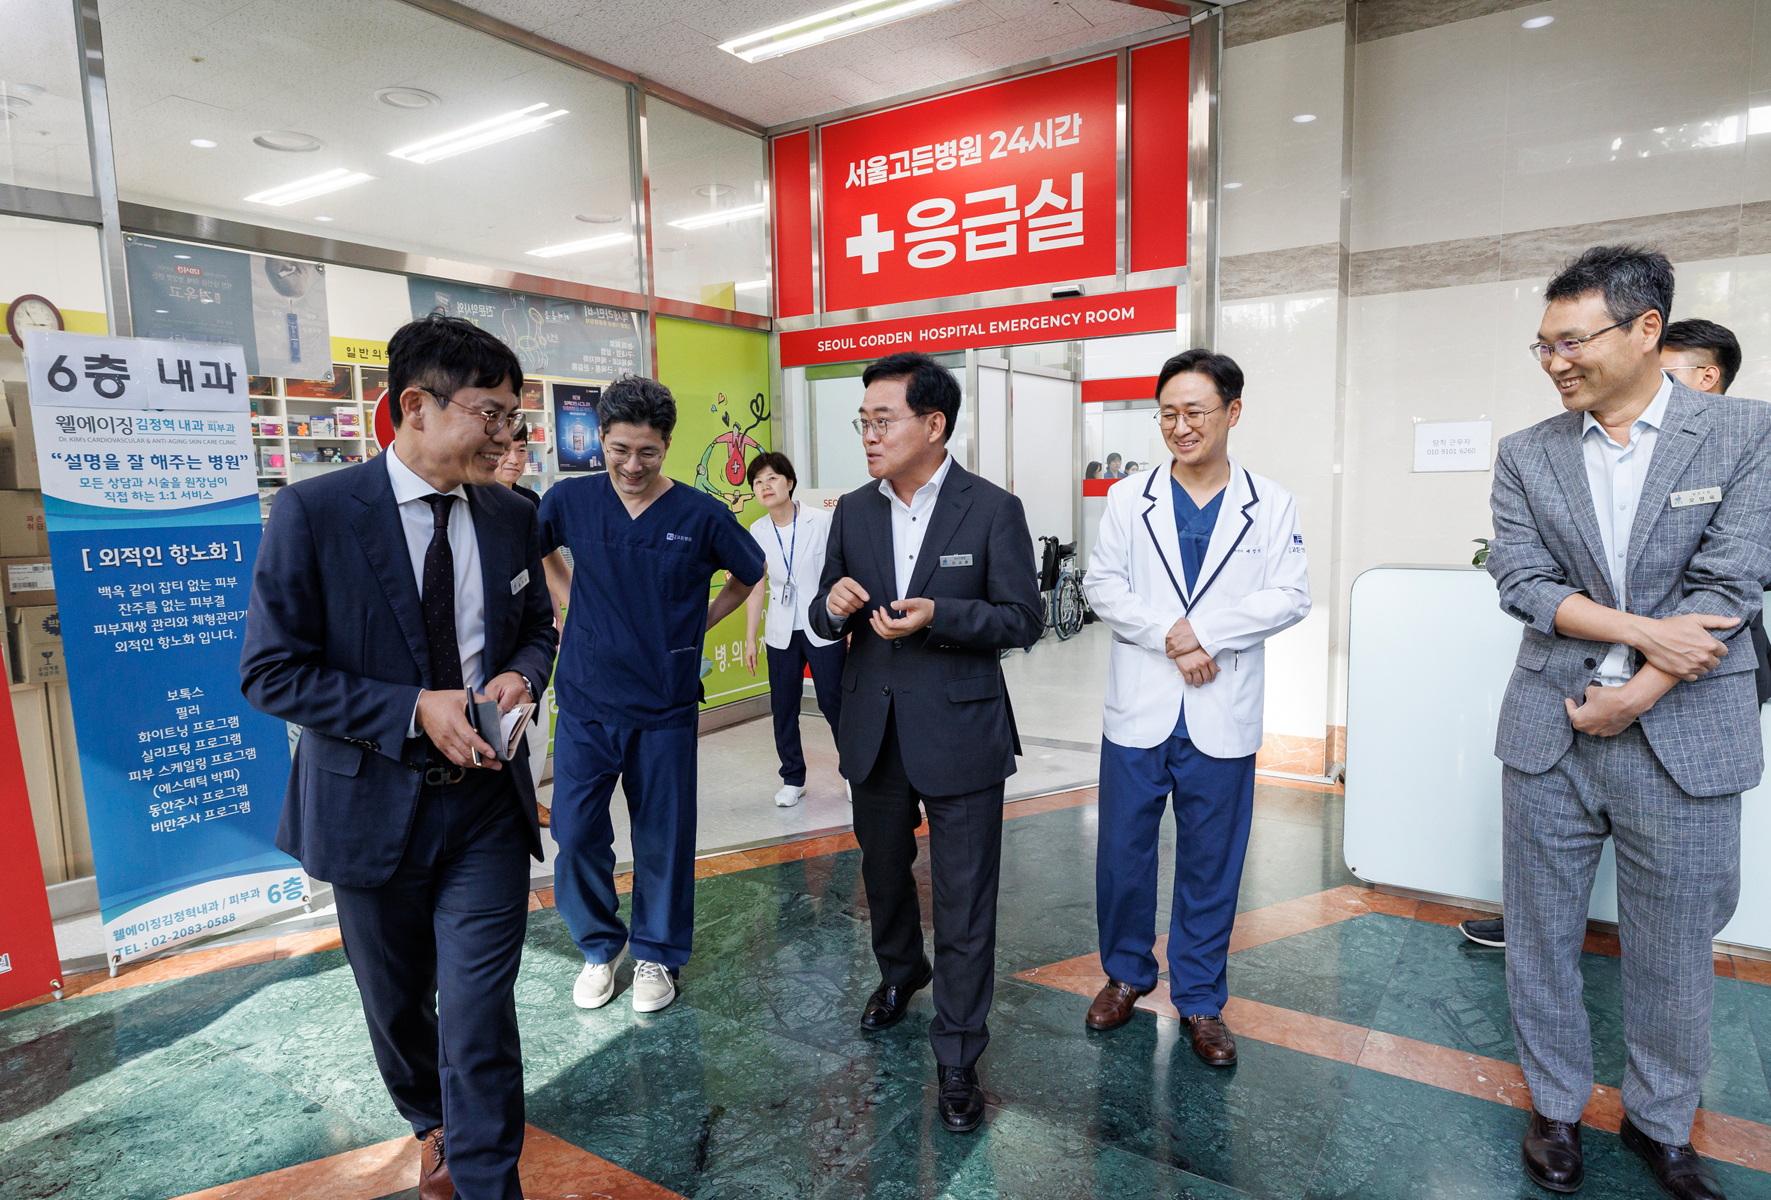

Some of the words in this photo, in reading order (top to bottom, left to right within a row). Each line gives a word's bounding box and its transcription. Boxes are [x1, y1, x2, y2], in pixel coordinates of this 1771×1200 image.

[845, 134, 981, 189] 서울고든병원
[989, 113, 1082, 160] 24시간
[904, 172, 1084, 269] 응급실
[817, 337, 856, 352] SEOUL
[859, 331, 912, 349] GORDEN
[919, 322, 985, 341] HOSPITAL
[989, 312, 1081, 335] EMERGENCY
[1085, 306, 1135, 324] ROOM
[47, 354, 131, 399] 6층
[157, 358, 237, 394] 내과
[55, 415, 133, 435] 웰에이징
[136, 418, 175, 431] 김정혁
[178, 419, 204, 432] 내과
[207, 423, 235, 433] 피부과
[1432, 439, 1447, 447] 당직
[1449, 438, 1471, 446] 근무자
[127, 453, 145, 471] 잘
[150, 454, 202, 471] 해주는
[79, 477, 104, 489] 모든
[108, 477, 143, 489] 상담과
[147, 477, 181, 489] 시술을
[185, 477, 228, 489] 원장님이
[104, 491, 128, 503] 직접
[131, 491, 155, 503] 하는
[159, 491, 177, 500] 1:1
[180, 491, 213, 500] 서비스
[99, 546, 163, 568] 외적인
[168, 542, 228, 566] 항노화
[98, 585, 126, 599] 백옥
[129, 582, 155, 597] 같이
[158, 580, 184, 594] 잡티
[187, 578, 212, 592] 없는
[214, 576, 238, 588] 피부
[118, 602, 158, 617] 잔주름
[161, 598, 186, 613] 없는
[190, 595, 226, 609] 피부결
[93, 620, 147, 636] 피부재생
[151, 616, 189, 632] 관리와
[115, 637, 154, 653] 외적인
[157, 633, 195, 650] 항노화
[198, 629, 237, 645] 입니다.
[167, 686, 205, 702] 보톡스
[175, 705, 200, 720] 필러
[138, 725, 189, 743] 화이트닝
[193, 715, 240, 733] 프로그램
[141, 742, 191, 762] 실리프팅
[195, 733, 242, 751] 프로그램
[128, 769, 155, 782] 피부
[158, 757, 207, 777] 스케일링
[211, 747, 257, 766] 프로그램
[153, 775, 208, 799] (에스테틱
[212, 767, 240, 785] 박피)
[148, 794, 199, 818] 동안주사
[202, 784, 249, 804] 프로그램
[151, 813, 201, 833] 비만주사
[204, 801, 251, 822] 프로그램
[112, 899, 219, 941] 웰에이징김정혁내과
[228, 887, 261, 906] 피부과
[267, 876, 304, 905] 6층
[115, 943, 141, 958] TEL
[152, 912, 236, 947] 02-2083-0588
